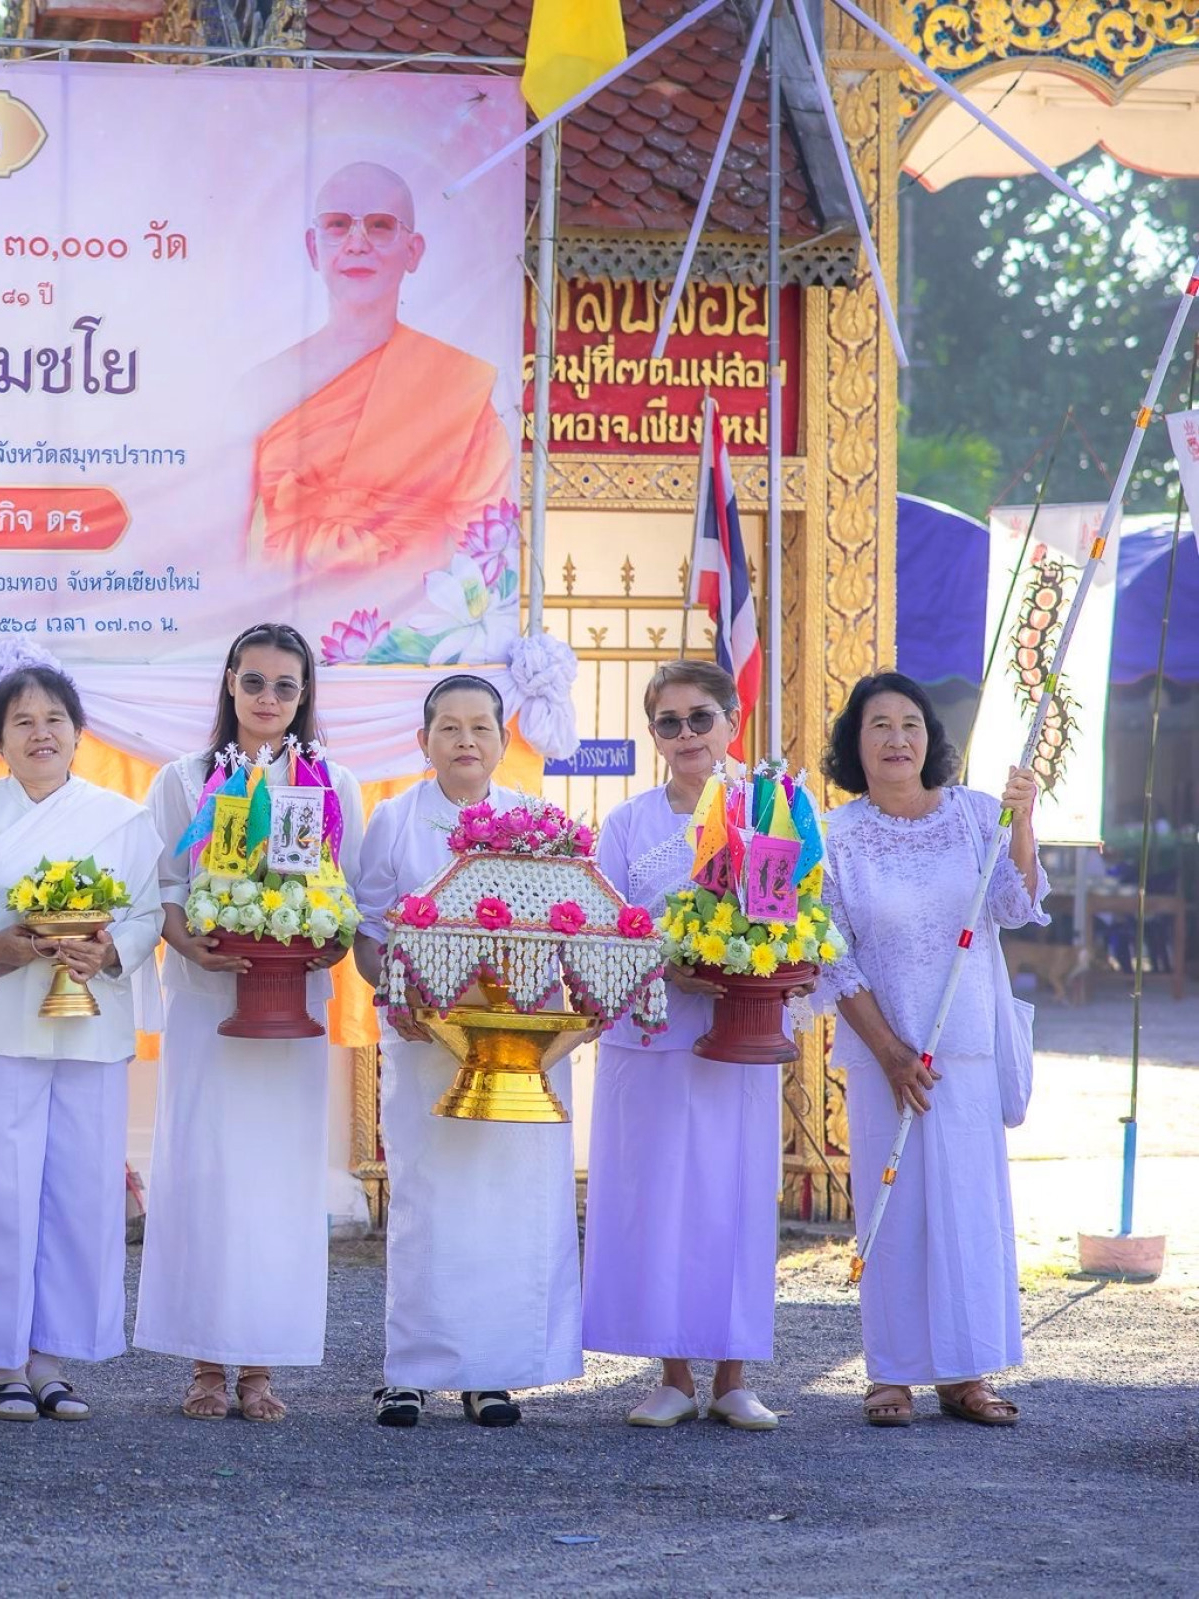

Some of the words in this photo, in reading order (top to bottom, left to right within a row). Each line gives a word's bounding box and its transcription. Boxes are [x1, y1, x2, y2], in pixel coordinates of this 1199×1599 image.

[4, 235, 129, 262] ๓๐,๐๐๐
[143, 219, 188, 261] วัด
[1, 288, 31, 307] ๘๑
[37, 281, 55, 306] ปี
[46, 509, 91, 533] ดร.
[66, 565, 200, 592] จังหวัดเชียงใหม่
[46, 616, 87, 633] เวลา
[94, 617, 153, 633] ๐๗.๓๐
[160, 616, 179, 633] น.
